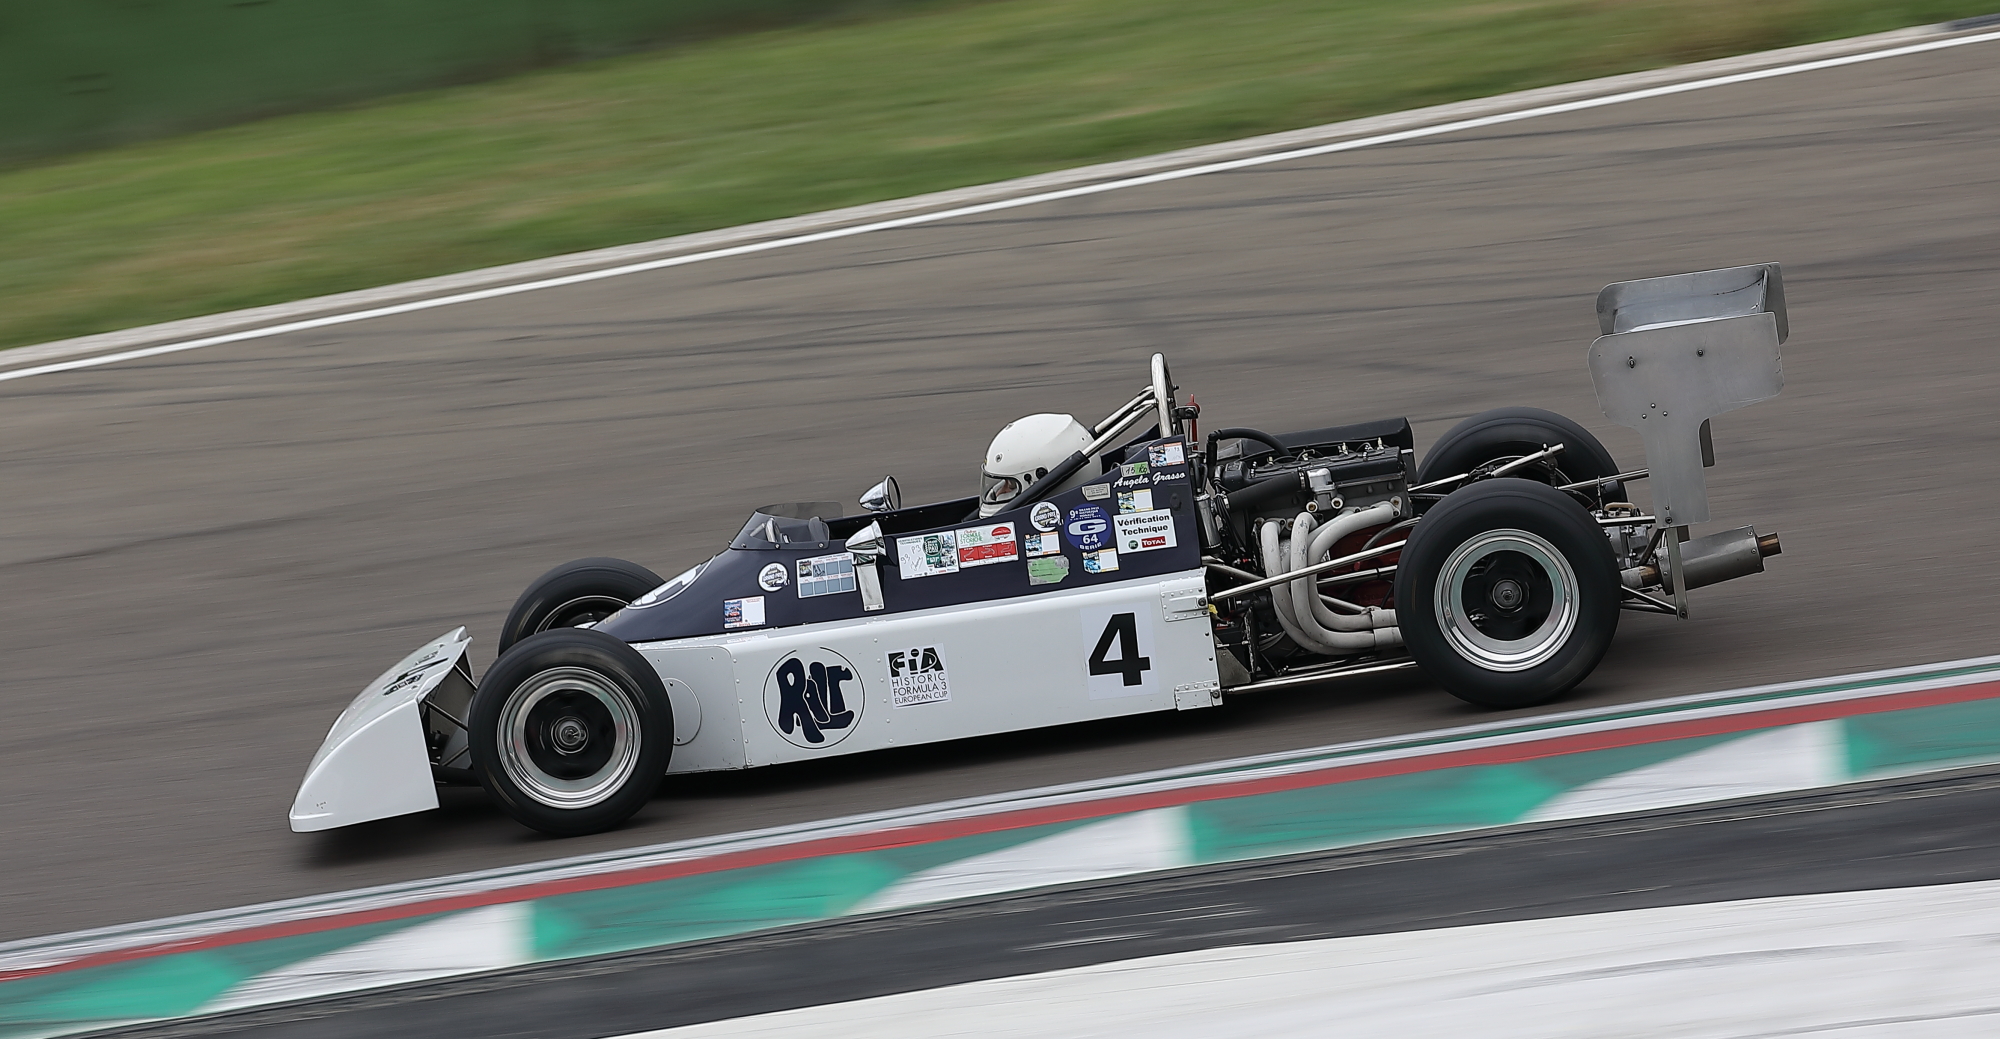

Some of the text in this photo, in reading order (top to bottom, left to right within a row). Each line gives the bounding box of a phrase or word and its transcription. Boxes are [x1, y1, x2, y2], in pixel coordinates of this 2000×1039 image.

[1112, 471, 1186, 489] Angela Grasso
[1068, 518, 1107, 536] G
[1117, 515, 1170, 527] Vérification
[1121, 525, 1169, 537] Technique
[1082, 533, 1099, 545] 64
[1142, 538, 1166, 546] TOTAL
[1088, 612, 1151, 687] 4
[891, 672, 946, 688] HISTORIC
[893, 681, 947, 697] FORMULA 3
[894, 691, 948, 705] EUROPEAN CUP
